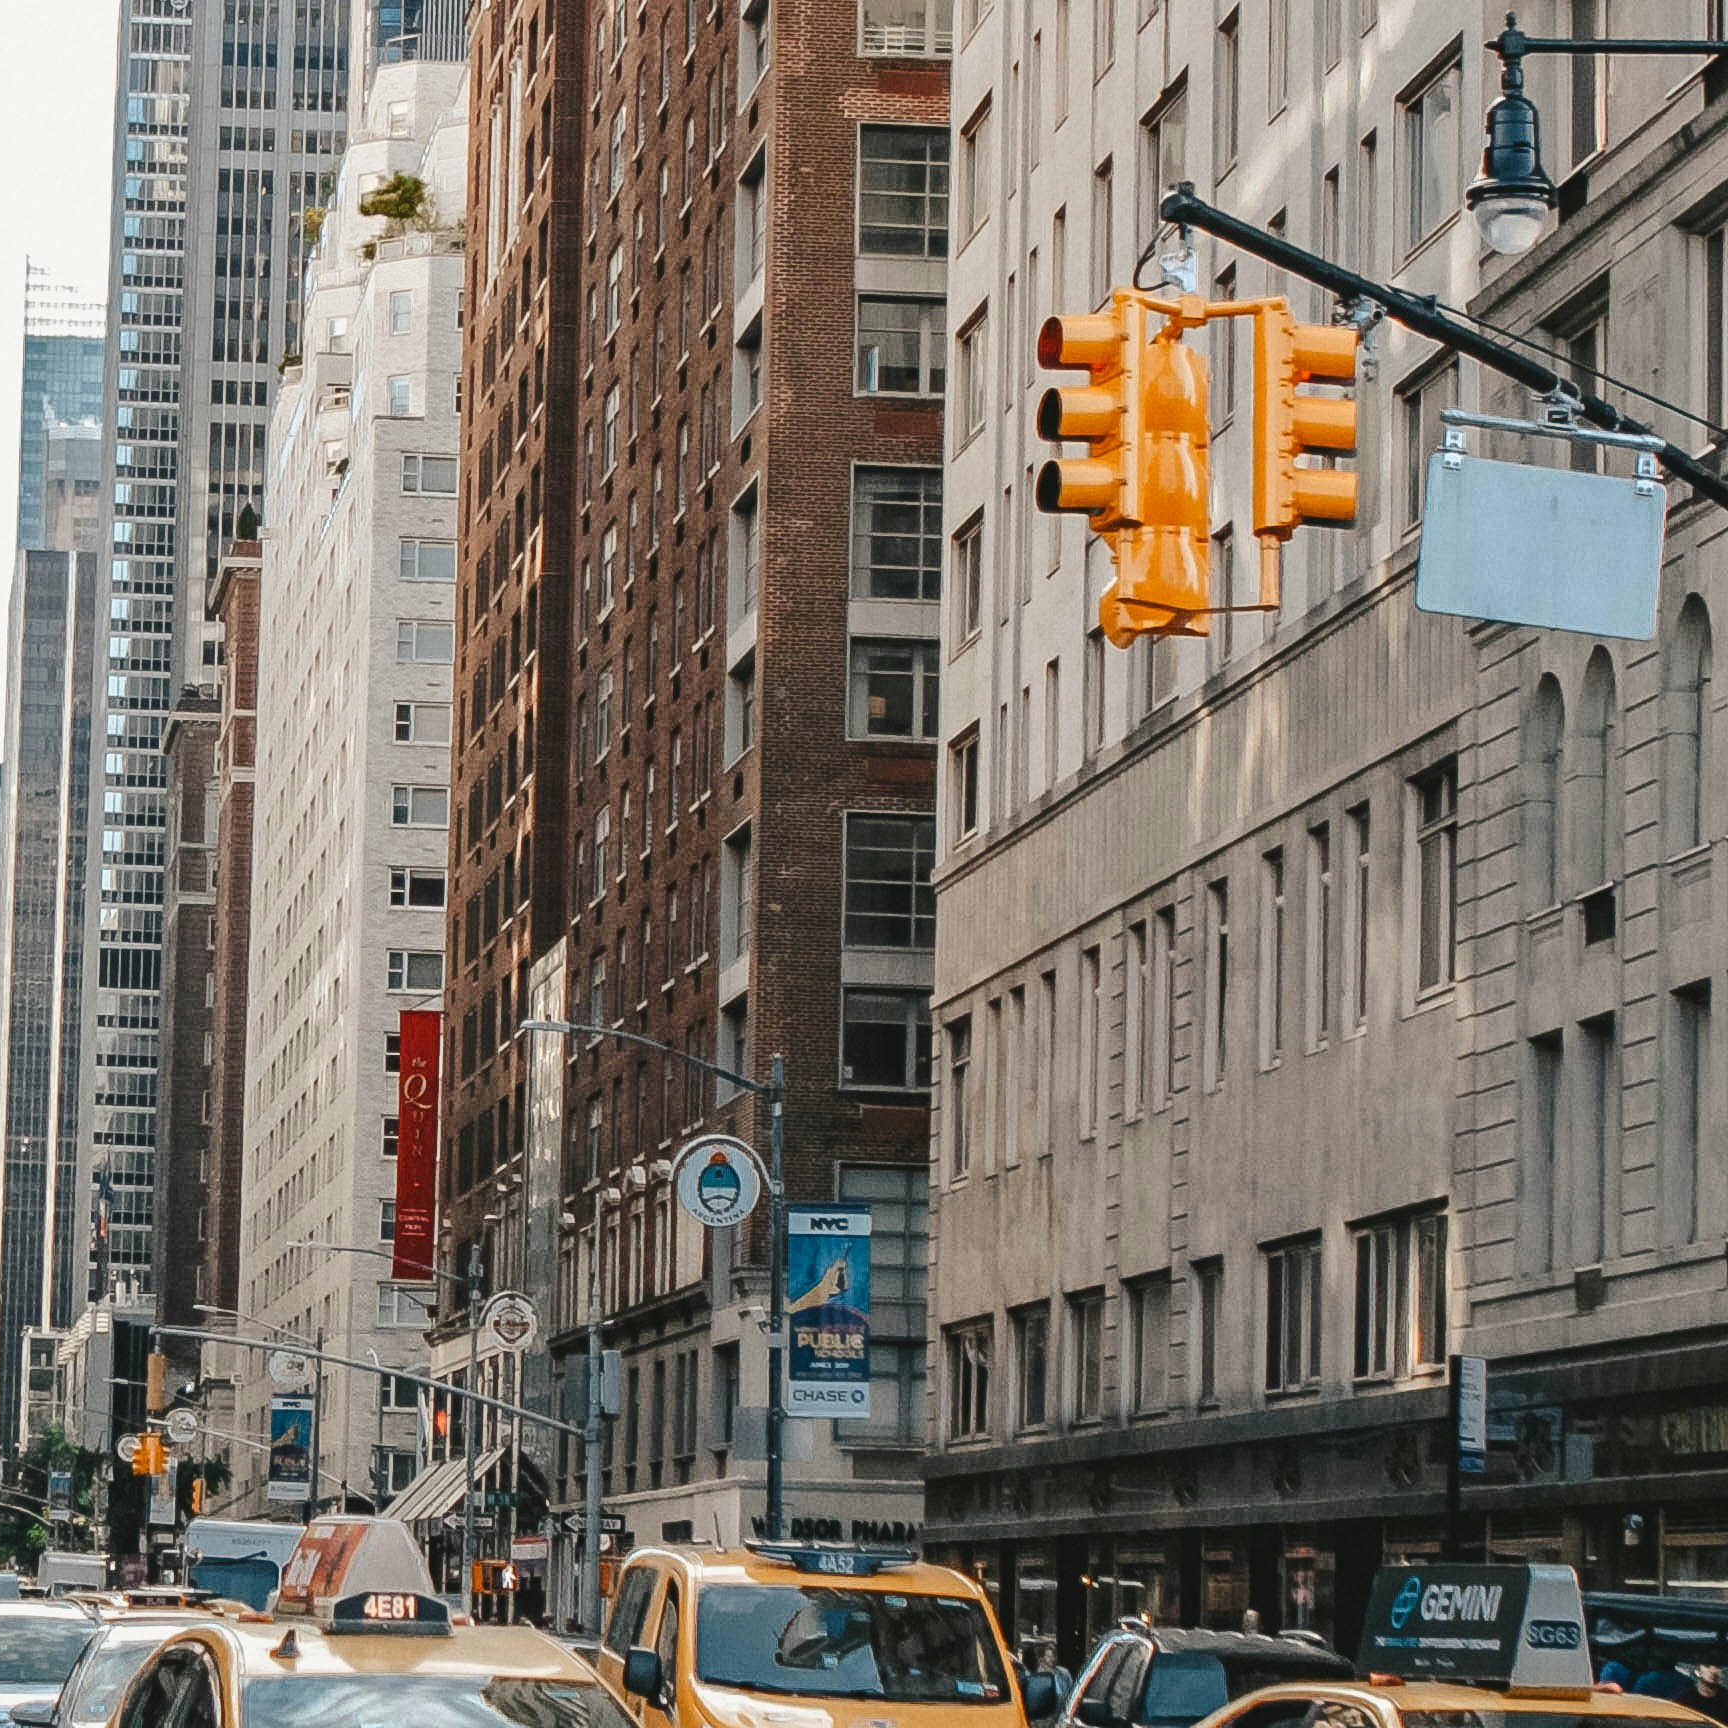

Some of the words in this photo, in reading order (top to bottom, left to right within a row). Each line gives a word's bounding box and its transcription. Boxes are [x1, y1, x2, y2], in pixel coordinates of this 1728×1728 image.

[692, 1208, 745, 1223] ARGENTINA
[810, 1217, 849, 1231] NYC
[797, 1332, 865, 1349] PUBLIC
[792, 1389, 848, 1402] CHASE
[751, 1516, 843, 1540] WDSOR
[818, 1554, 855, 1574] 4A52
[363, 1594, 418, 1620] 4E81
[1421, 1584, 1503, 1622] GEMINI
